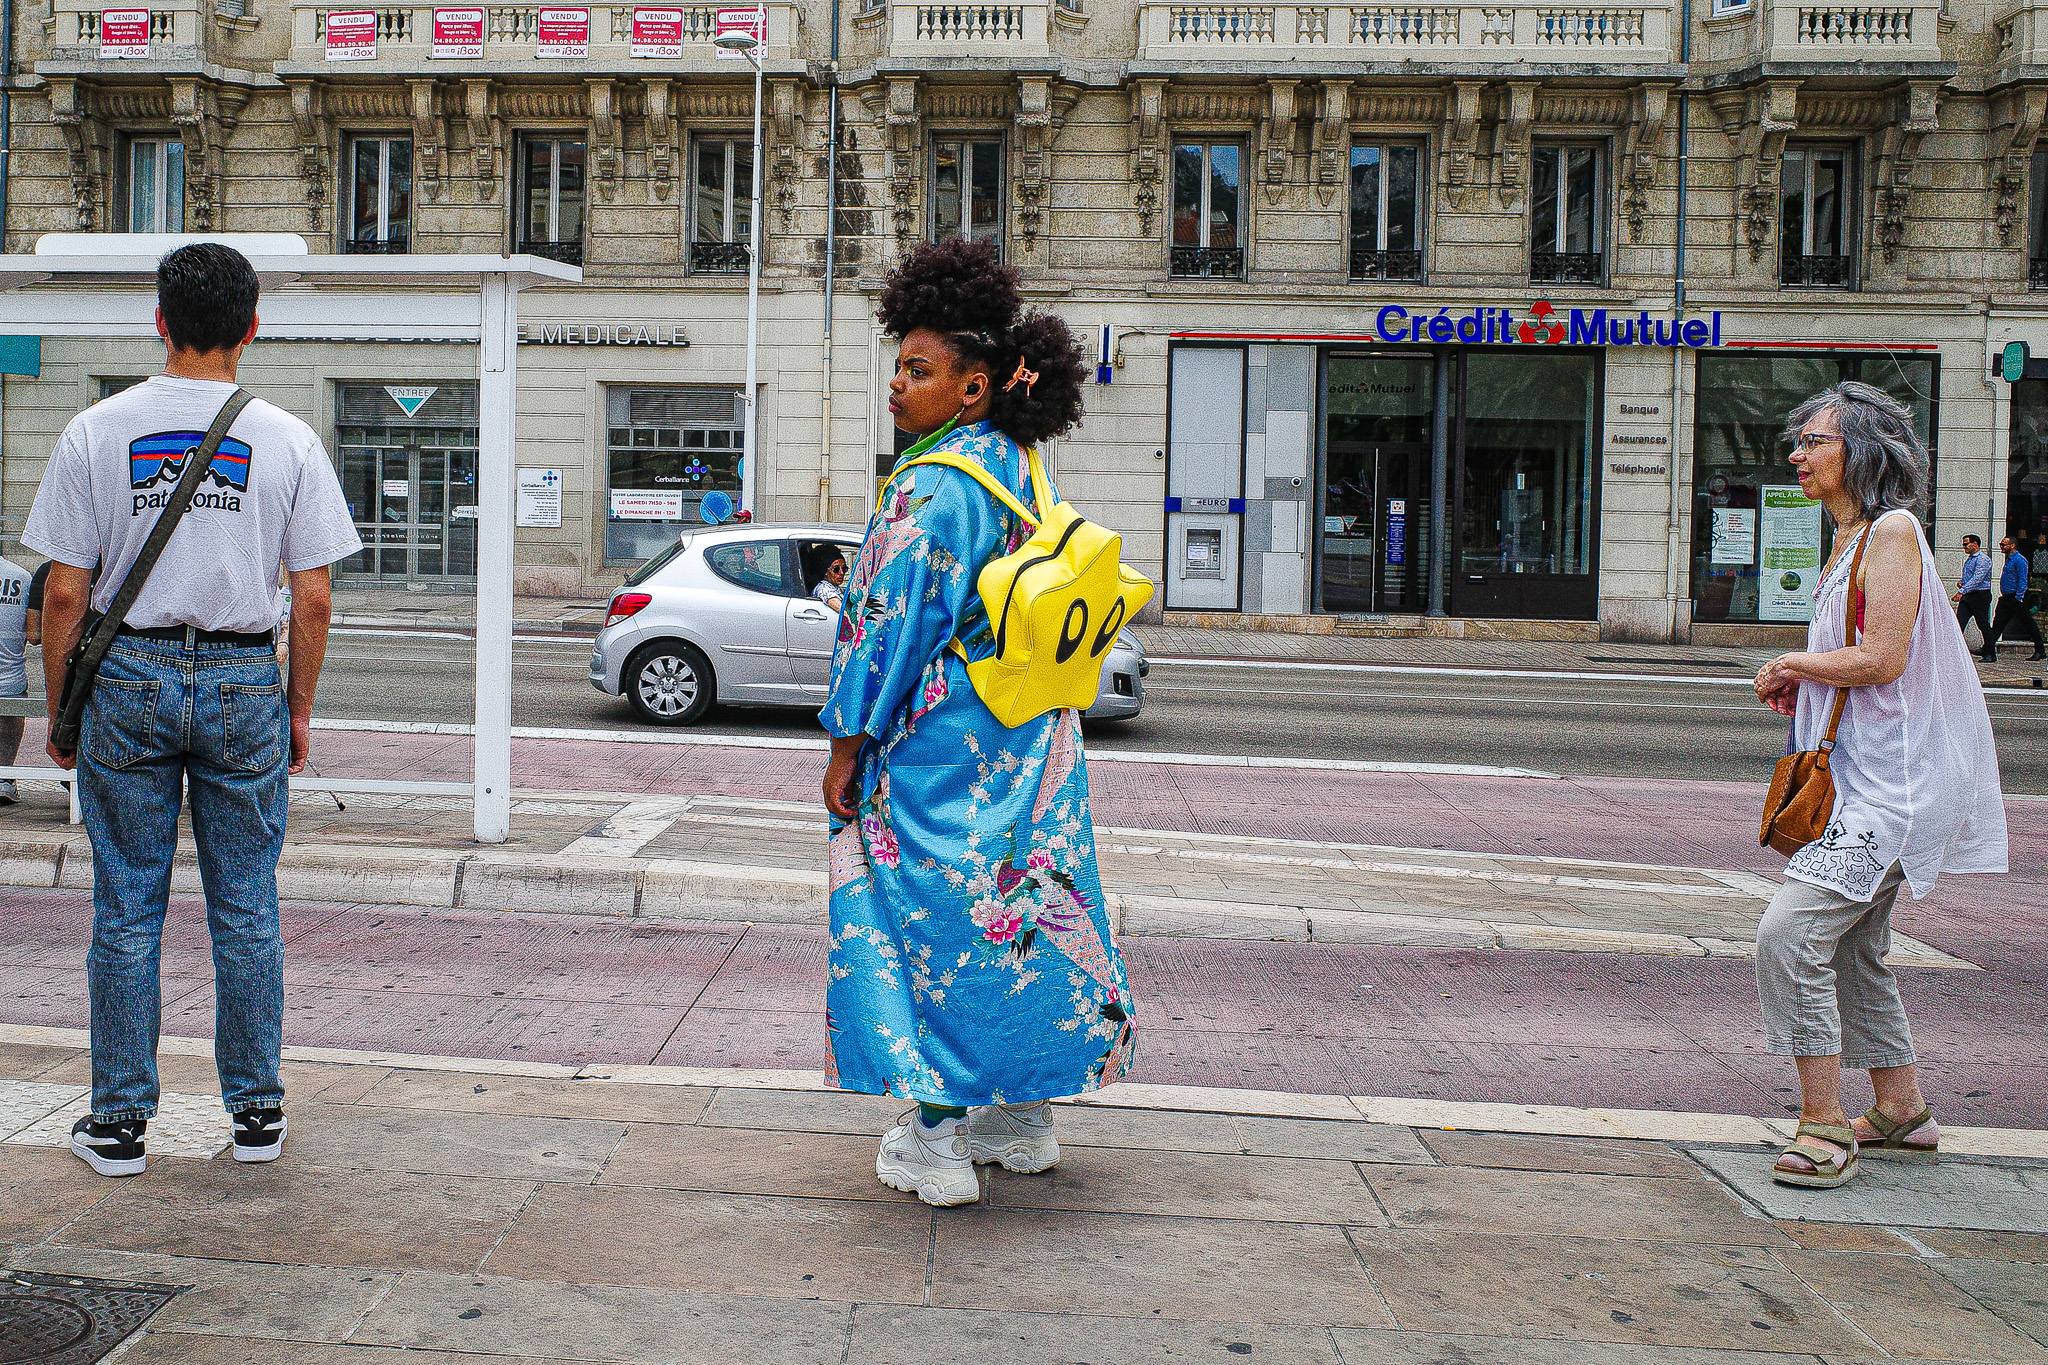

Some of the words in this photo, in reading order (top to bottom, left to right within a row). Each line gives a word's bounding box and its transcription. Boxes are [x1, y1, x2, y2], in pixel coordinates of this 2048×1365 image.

[1375, 305, 1513, 344] Crédit
[1568, 308, 1722, 347] Mutuel
[540, 324, 687, 346] MEDICALE
[392, 388, 430, 396] ENTREE
[1620, 404, 1659, 415] Banque
[1611, 434, 1667, 444] Assurances
[1610, 464, 1666, 475] Téléphonie
[655, 475, 690, 483] Cerballiance
[131, 489, 241, 516] patonia
[1202, 499, 1227, 507] EURO
[0, 578, 21, 596] IS
